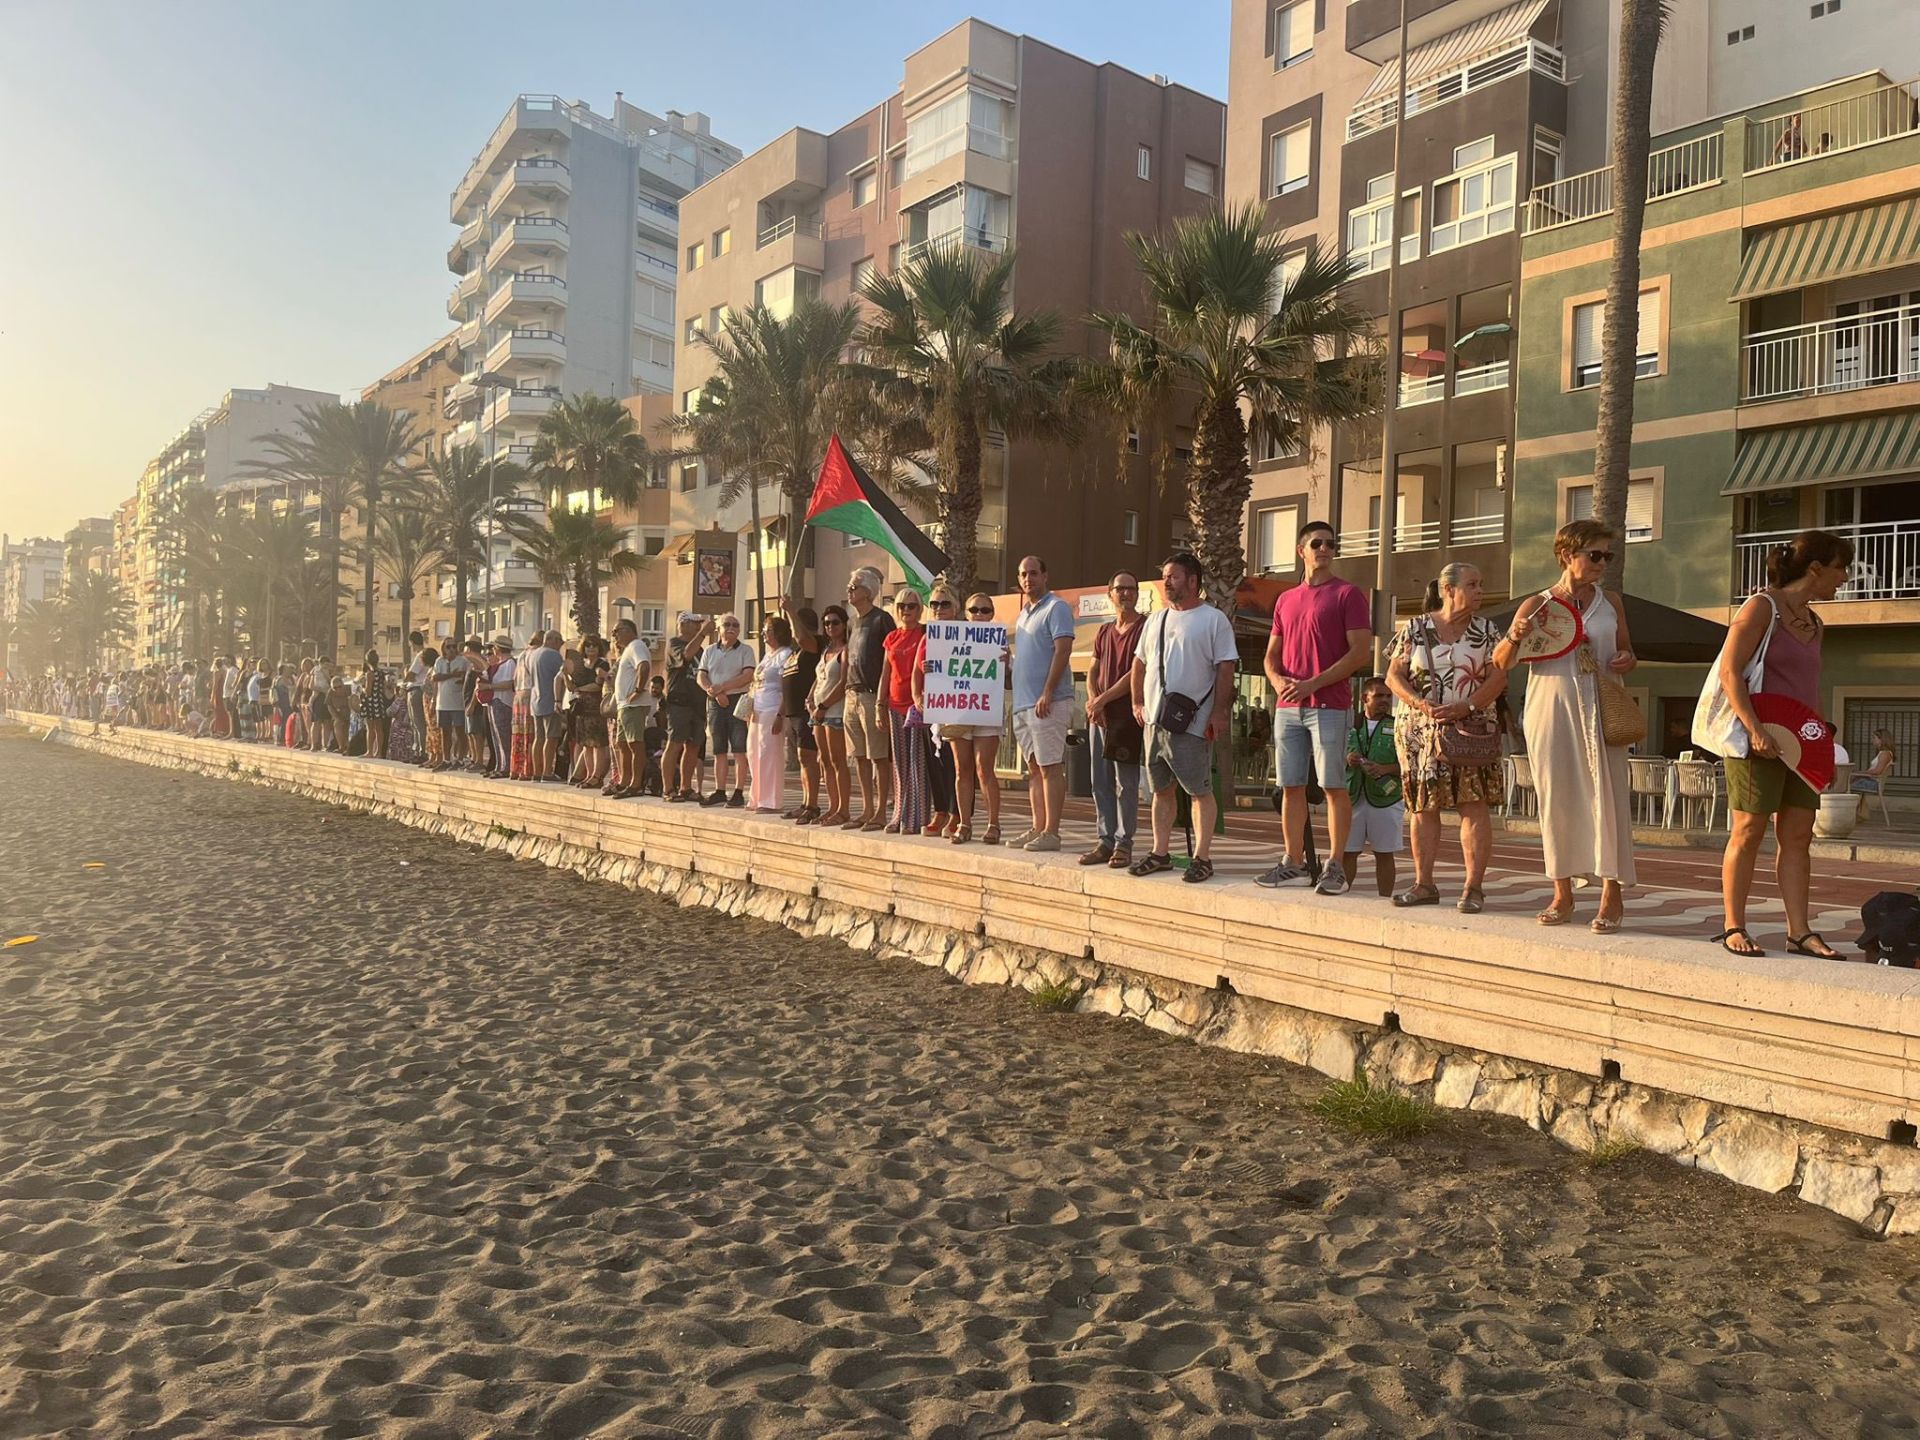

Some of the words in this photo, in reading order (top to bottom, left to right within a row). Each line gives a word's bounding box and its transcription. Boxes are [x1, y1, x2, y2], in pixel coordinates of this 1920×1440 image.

[1083, 599, 1109, 612] PLAZA
[928, 625, 940, 639] NI
[945, 626, 959, 641] UN
[952, 643, 972, 656] MÁS
[928, 660, 942, 673] EN
[948, 658, 997, 680] GAZA
[954, 680, 970, 690] POR
[927, 693, 990, 711] HAMBRE
